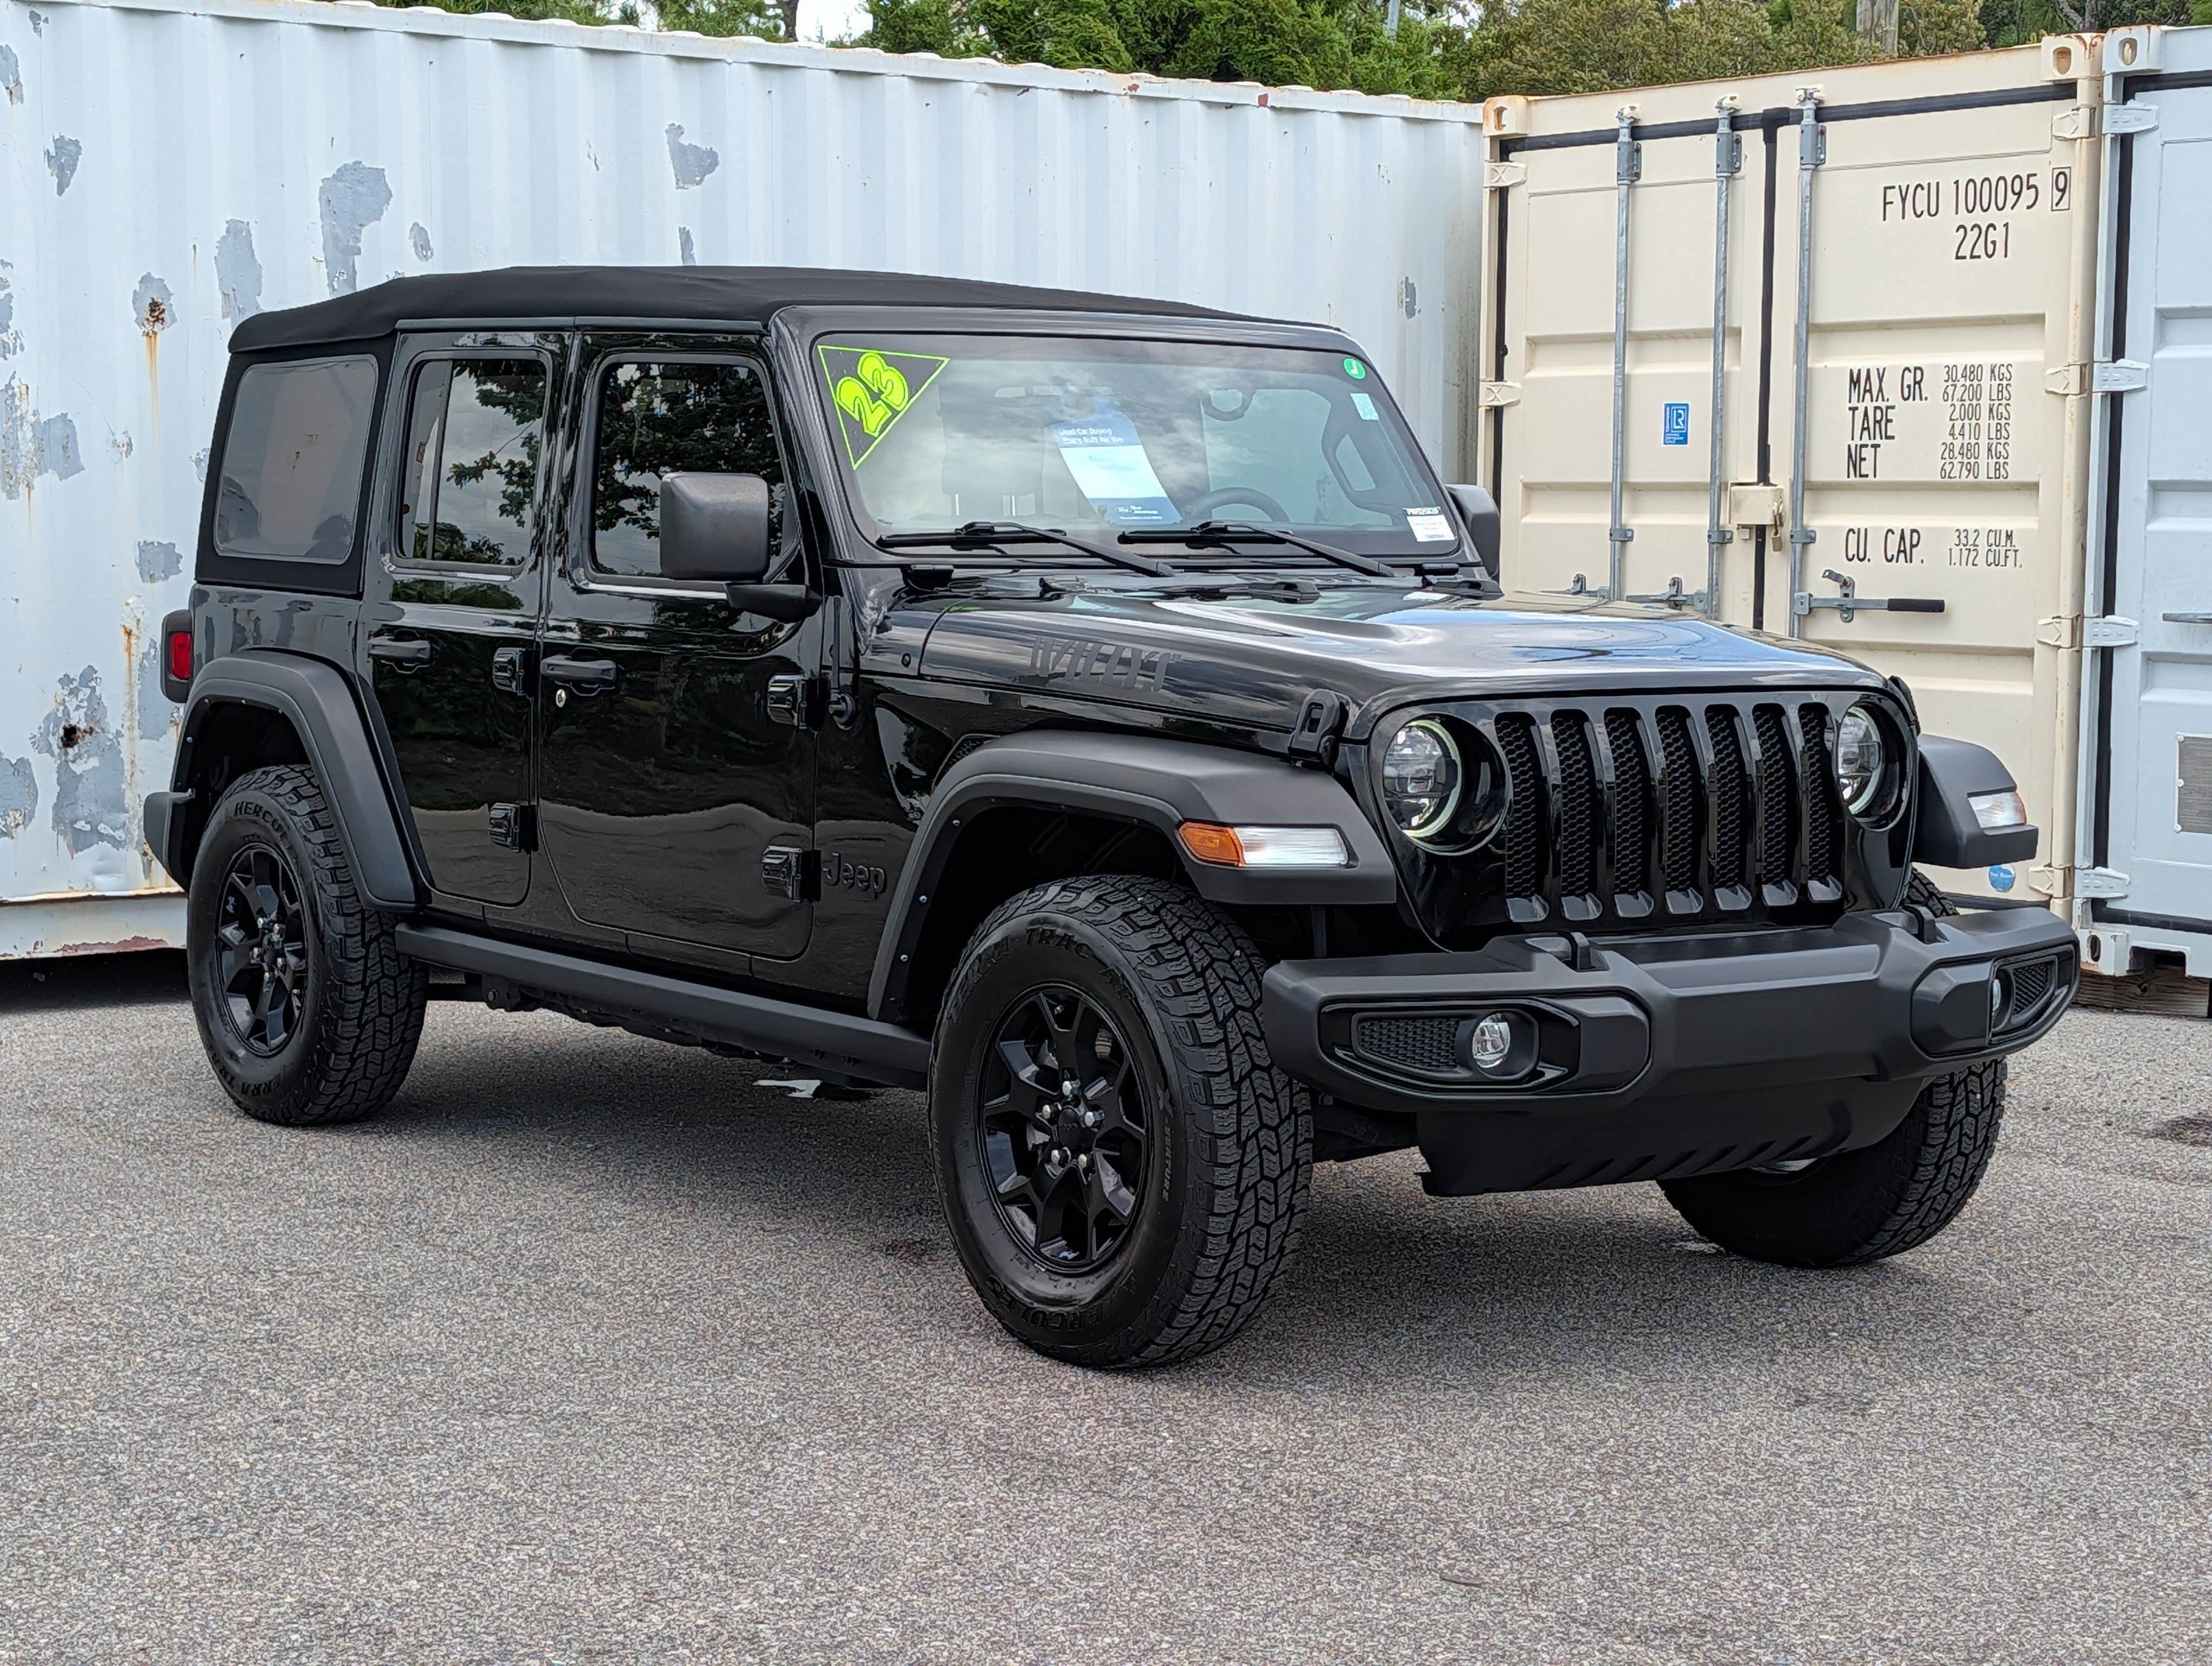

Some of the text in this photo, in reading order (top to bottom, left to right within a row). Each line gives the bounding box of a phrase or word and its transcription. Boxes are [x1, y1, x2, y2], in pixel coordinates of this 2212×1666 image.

[1882, 170, 2068, 221] FYCU 100095 9
[1954, 221, 2010, 260] 22G1
[836, 352, 909, 438] 23
[1848, 367, 1890, 403] MAX.
[1900, 366, 1928, 401] GR.
[1990, 363, 2013, 382] KGS
[1989, 383, 2012, 401] LBS
[1848, 405, 1896, 441] TARE
[1988, 402, 2011, 421] KGS
[1987, 422, 2010, 440] LBS
[1847, 443, 1881, 479] NET
[1986, 441, 2010, 460] KGS
[1986, 461, 2009, 479] LBS
[1845, 528, 1871, 562] CU.
[1883, 528, 1924, 563] CAP.
[822, 852, 888, 901] Jeep
[985, 1275, 1109, 1333] ERCULES
